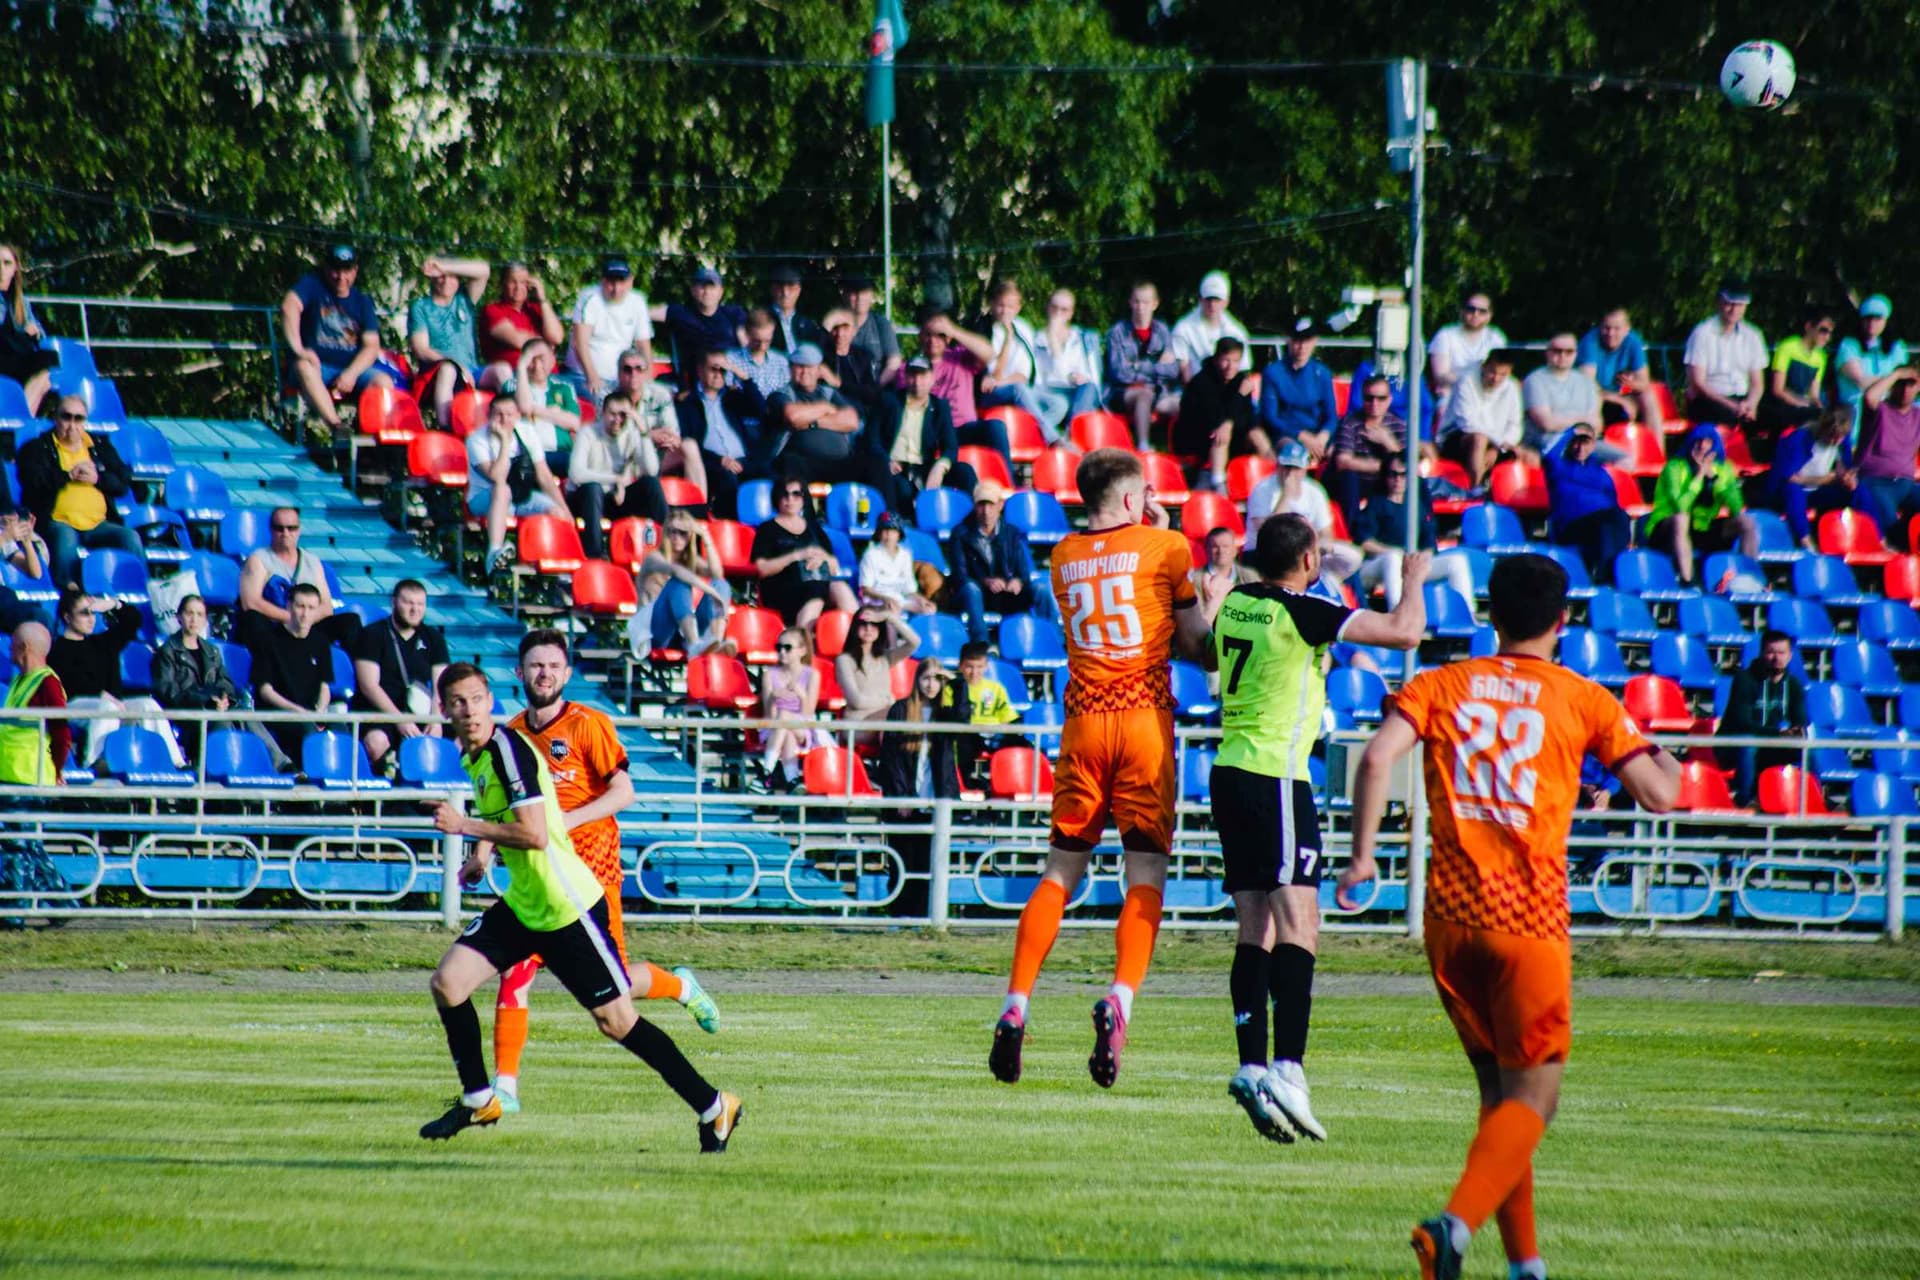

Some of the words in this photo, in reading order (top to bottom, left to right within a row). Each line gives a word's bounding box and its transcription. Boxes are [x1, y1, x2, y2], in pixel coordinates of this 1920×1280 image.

[1061, 552, 1140, 584] НОВИЧКОВ
[1068, 574, 1143, 649] 25
[1222, 635, 1253, 696] 7
[1454, 700, 1546, 808] 22
[1299, 846, 1318, 877] 7
